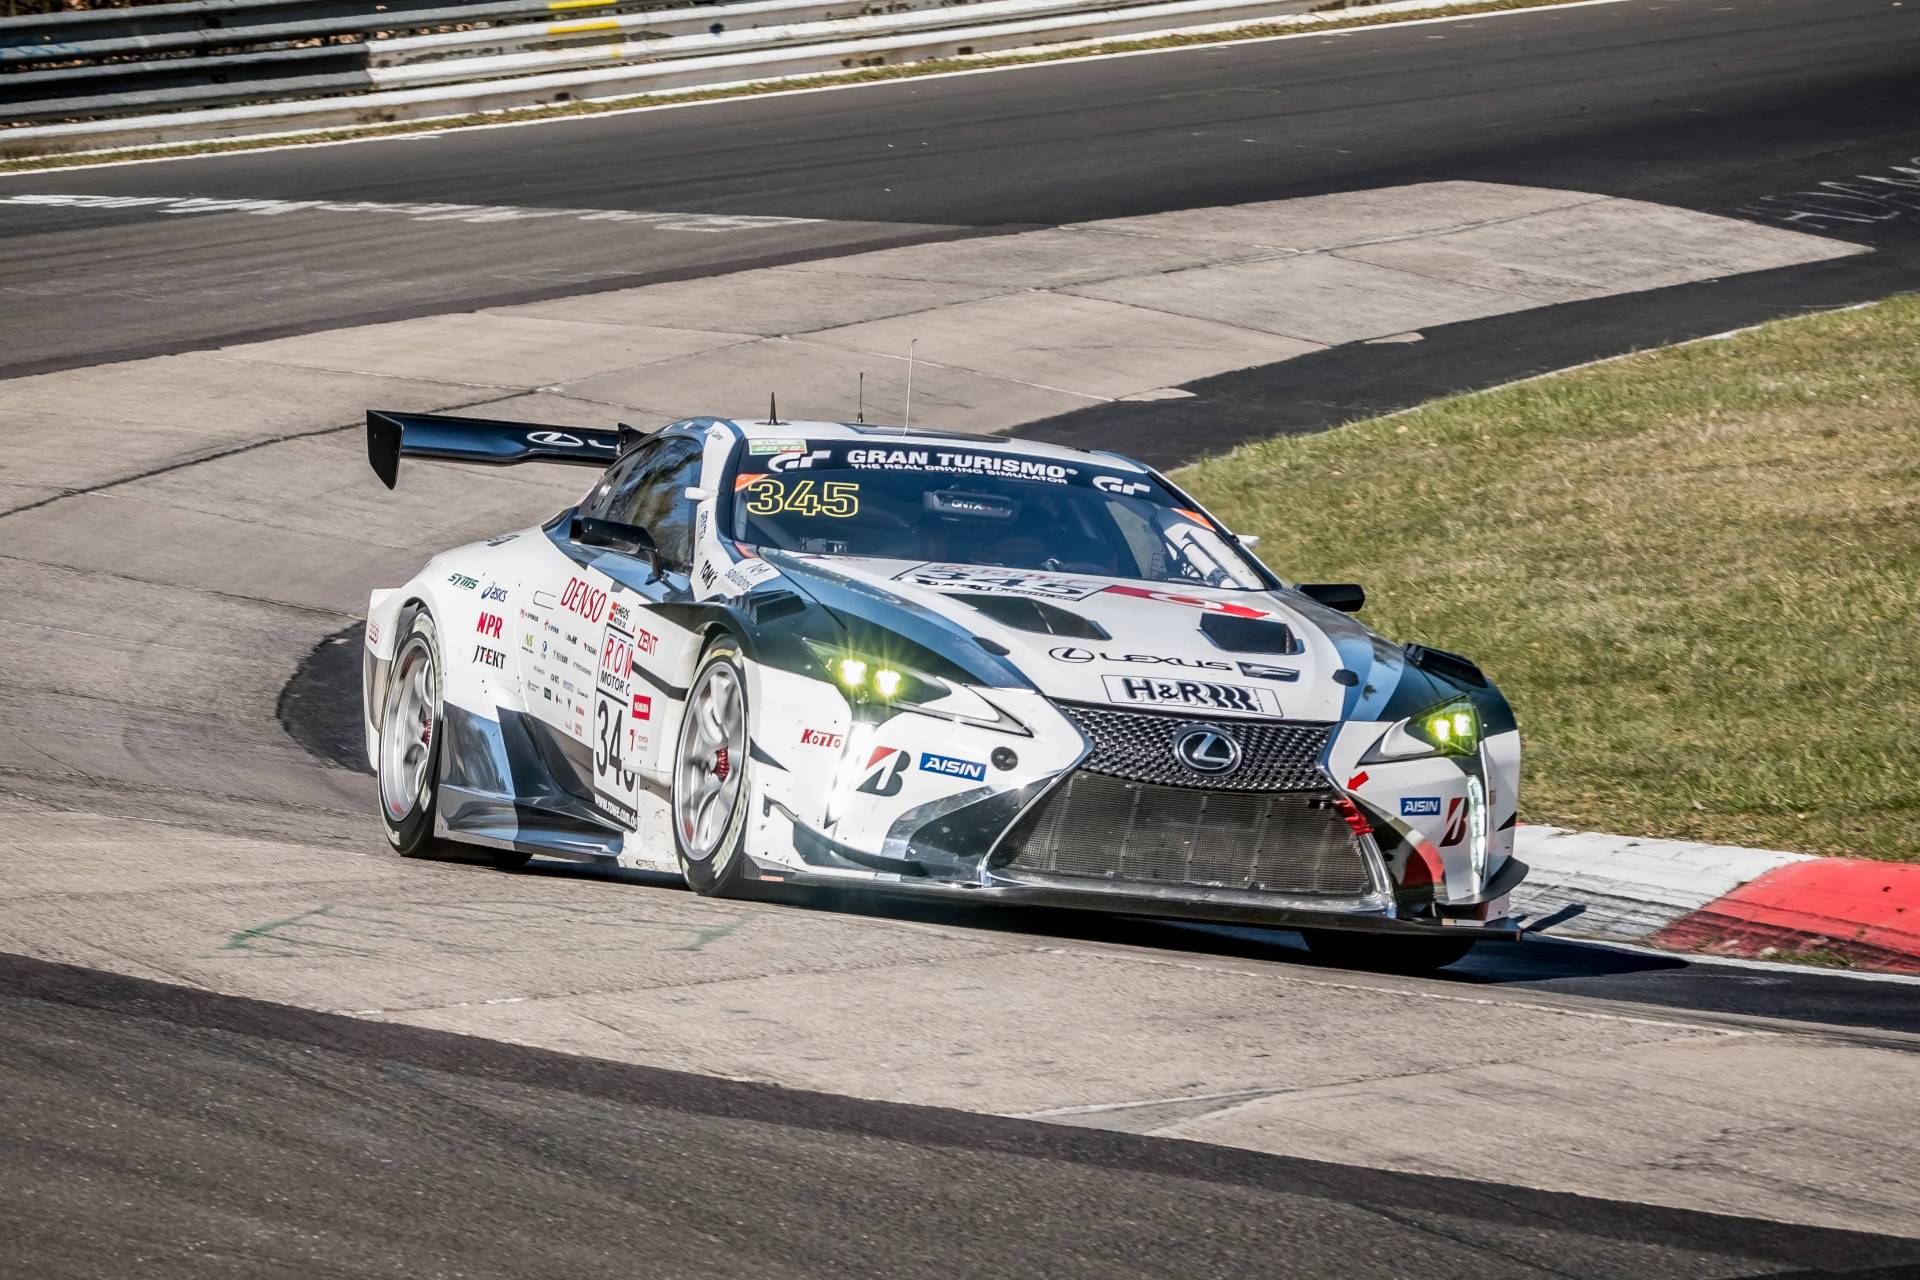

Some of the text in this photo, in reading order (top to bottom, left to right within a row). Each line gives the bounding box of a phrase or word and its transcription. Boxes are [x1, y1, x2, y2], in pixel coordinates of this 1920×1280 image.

[847, 449, 929, 465] GRAN
[924, 465, 984, 475] DRIVING
[986, 469, 1068, 485] SIMULATOR
[747, 479, 860, 518] 345
[915, 569, 1083, 594] 345
[560, 577, 607, 623] DENSO
[476, 611, 503, 639] NPR
[637, 628, 659, 656] ZENT
[472, 645, 507, 669] JTEKT
[1099, 652, 1234, 671] LEXUS
[600, 670, 631, 697] MOTOR C
[924, 757, 983, 778] AISIN
[1404, 800, 1439, 813] AISIN
